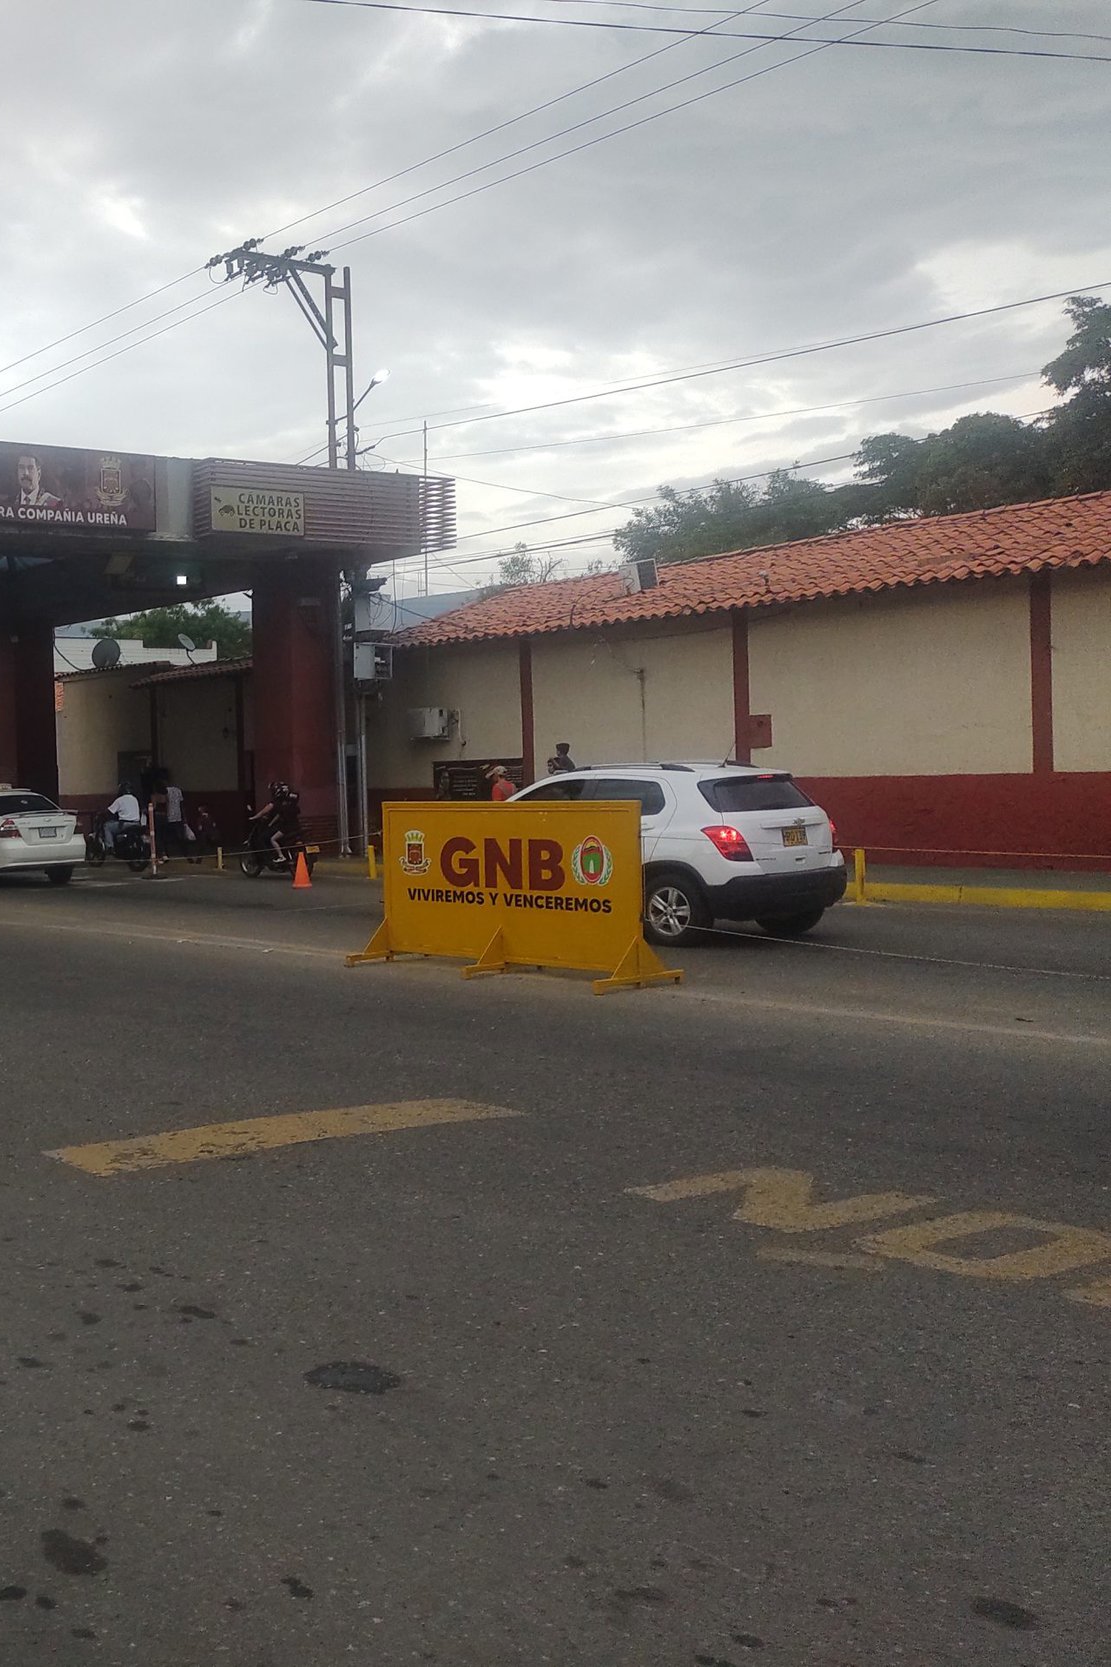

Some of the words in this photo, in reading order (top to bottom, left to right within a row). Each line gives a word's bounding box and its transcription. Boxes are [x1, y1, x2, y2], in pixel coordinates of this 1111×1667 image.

[238, 491, 300, 508] CÁMARAS
[18, 507, 84, 524] COMPAÑIA
[87, 511, 127, 526] UREÑA
[237, 504, 301, 520] LECTORAS
[239, 518, 255, 530] DE
[259, 518, 300, 533] PLACA
[440, 836, 566, 892] GNB
[408, 887, 485, 906] VIVIREMOS
[489, 892, 499, 907] Y
[504, 893, 613, 914] VENCEREMOS
